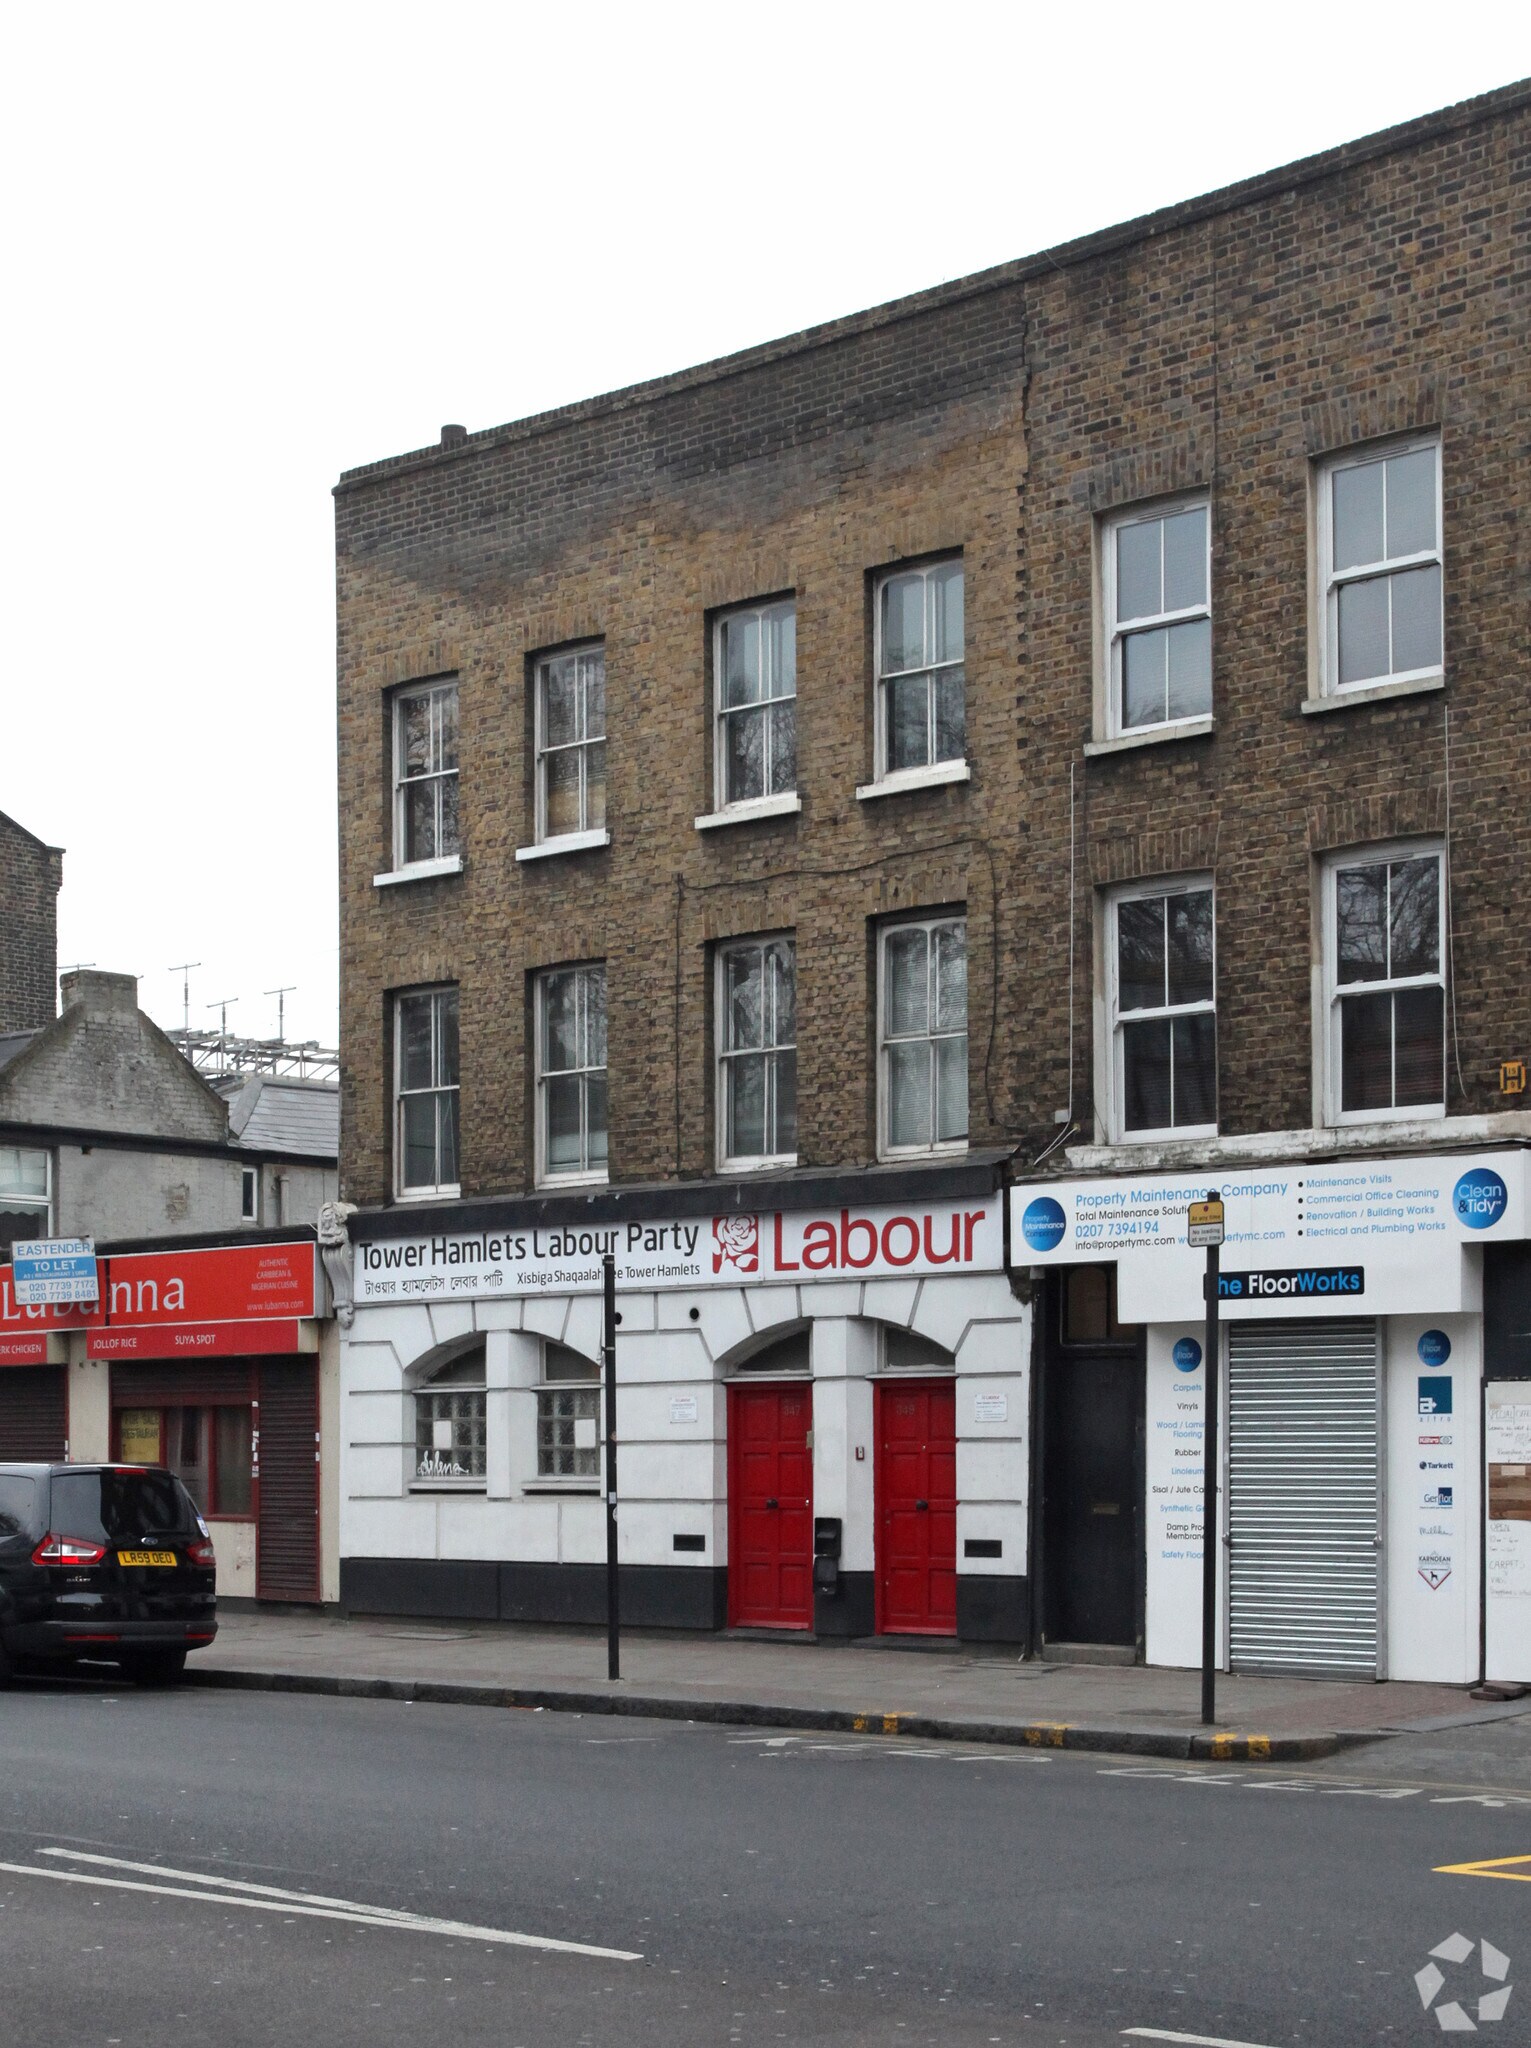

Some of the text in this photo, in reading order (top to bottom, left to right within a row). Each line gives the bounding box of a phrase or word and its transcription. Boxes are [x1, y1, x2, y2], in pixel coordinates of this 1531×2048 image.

[1306, 1174, 1393, 1188] Maintenance Visits
[1075, 1192, 1127, 1208] Property
[1221, 1183, 1289, 1198] Company
[1306, 1188, 1440, 1204] Commercial Office Cleaning
[1457, 1184, 1502, 1199] Clean
[1075, 1211, 1097, 1221] Total
[1098, 1208, 1160, 1220] Maintenance
[1306, 1210, 1358, 1221] Renovation
[1367, 1206, 1404, 1218] Building
[1406, 1204, 1435, 1215] Works
[1025, 1222, 1065, 1230] Maintenance
[1075, 1221, 1159, 1238] 0207 7394194
[1306, 1220, 1446, 1237] Electrical and Plumbing Works
[358, 1221, 699, 1270] Tower Hamlets Labour Party
[773, 1208, 986, 1272] Labour
[1075, 1237, 1176, 1251] info@propertymc.com
[33, 1259, 77, 1272] TO LET
[259, 1257, 289, 1267] AUTHENTIC
[256, 1270, 287, 1279] CARIBBEAN
[517, 1272, 553, 1286] Xisbiga
[625, 1265, 656, 1279] Tower
[657, 1263, 700, 1277] Hamlets
[29, 1282, 46, 1292] 020
[48, 1281, 72, 1291] 7739
[74, 1279, 96, 1289] 7172
[251, 1280, 299, 1291] NIGERIAN CUISINE
[1218, 1276, 1242, 1295] he
[29, 1292, 47, 1302] 020
[49, 1291, 72, 1301] 7739
[93, 1337, 138, 1350] JOLLOF RICE
[175, 1334, 216, 1345] SUYA SPOT
[11, 1343, 42, 1355] CHICKEN
[1172, 1384, 1202, 1392] Carpets
[1177, 1403, 1199, 1411] Vinyls
[1156, 1421, 1178, 1429] Wood
[1173, 1431, 1203, 1439] Flooring
[1174, 1449, 1202, 1457] Rubber
[1423, 1493, 1453, 1503] Gerflor
[1160, 1505, 1194, 1513] Synthetic
[1166, 1523, 1189, 1531] Damp
[122, 1552, 150, 1564] LR59
[1162, 1551, 1184, 1560] Safety
